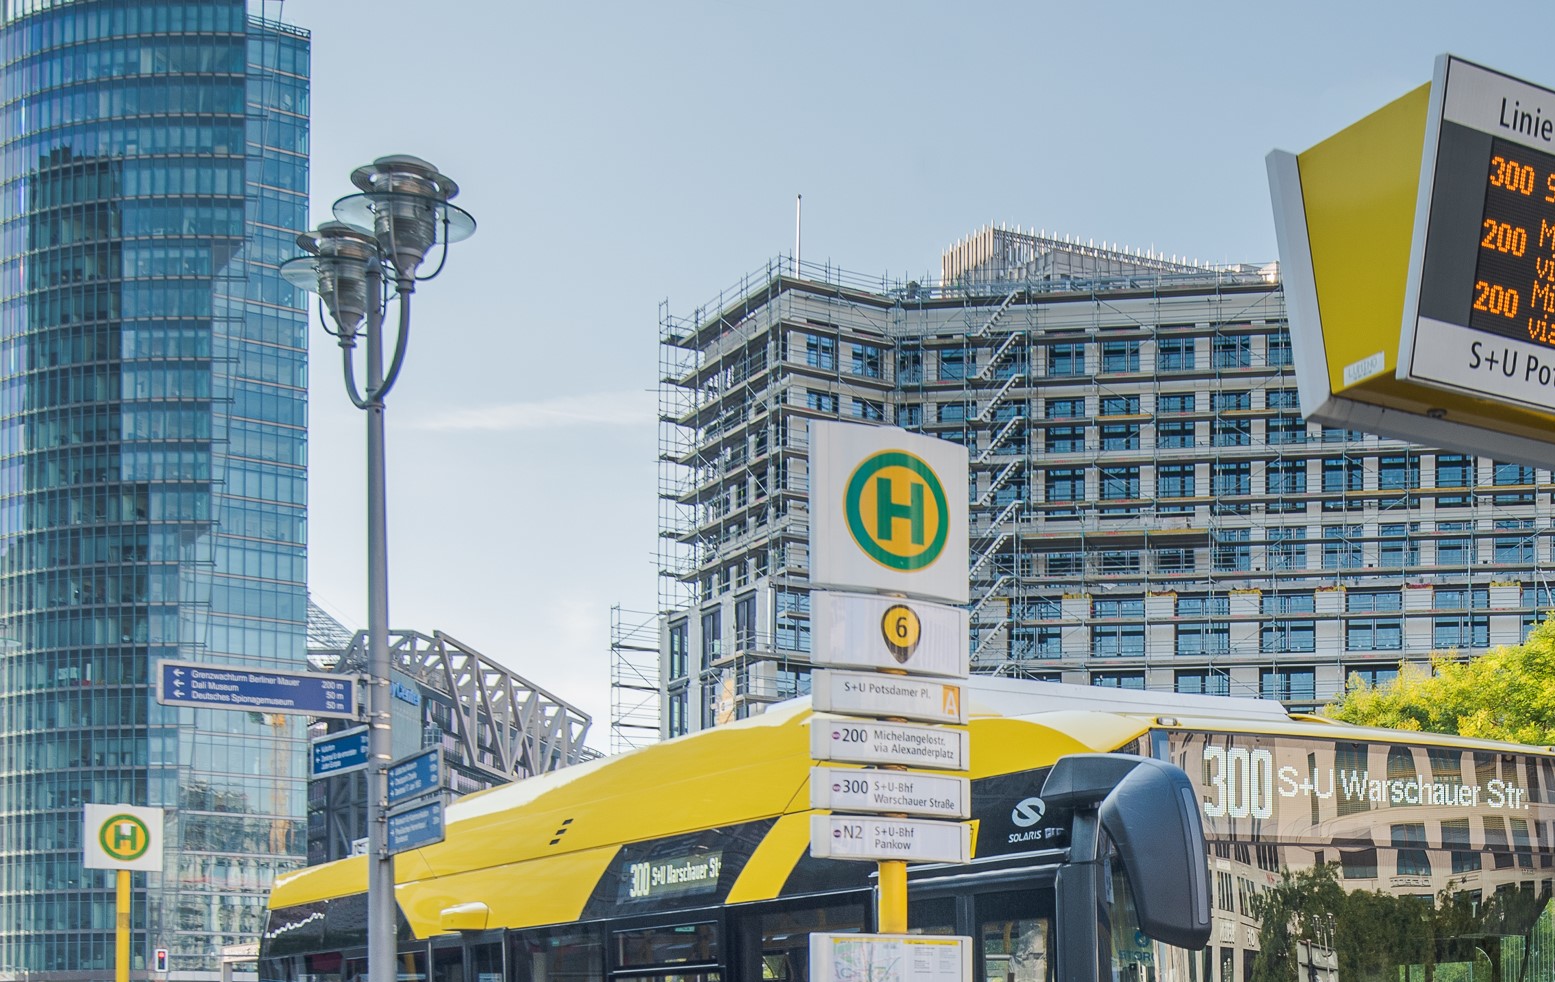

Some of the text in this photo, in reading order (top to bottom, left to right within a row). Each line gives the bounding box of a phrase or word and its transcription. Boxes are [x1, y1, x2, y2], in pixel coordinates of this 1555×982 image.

[1500, 98, 1553, 141] Linie
[1490, 155, 1535, 196] 300
[1481, 218, 1527, 257] 200
[1473, 280, 1519, 319] 200
[1469, 341, 1518, 377] S+U
[877, 477, 925, 546] H
[896, 616, 908, 639] 6
[191, 670, 300, 687] Grenzwachturm Berliner Mauer
[208, 681, 239, 692] Museum
[321, 680, 345, 690] 200 m
[191, 690, 294, 707] Deutsches Spionagemuseum
[326, 690, 345, 700] 50 m
[844, 681, 931, 699] S+U Potsdamer Pl.
[326, 700, 345, 710] 50 m
[943, 690, 959, 719] A
[842, 728, 868, 743] 200
[874, 730, 946, 746] Michelangelostr.
[874, 743, 954, 759] via Alexanderplatz
[843, 779, 869, 794] 300
[874, 781, 914, 793] S+U-Bhf
[1203, 745, 1529, 819] 300 S+U Warschauer Str.
[874, 794, 955, 810] Warschauer Straße
[114, 825, 137, 851] H
[843, 825, 863, 839] N2
[875, 826, 914, 837] S+U-Bhf
[1008, 830, 1042, 843] SOLARIS
[875, 840, 911, 850] Pankow
[629, 862, 651, 897] 300
[651, 865, 666, 886] S+U
[666, 861, 708, 884] Warschauer
